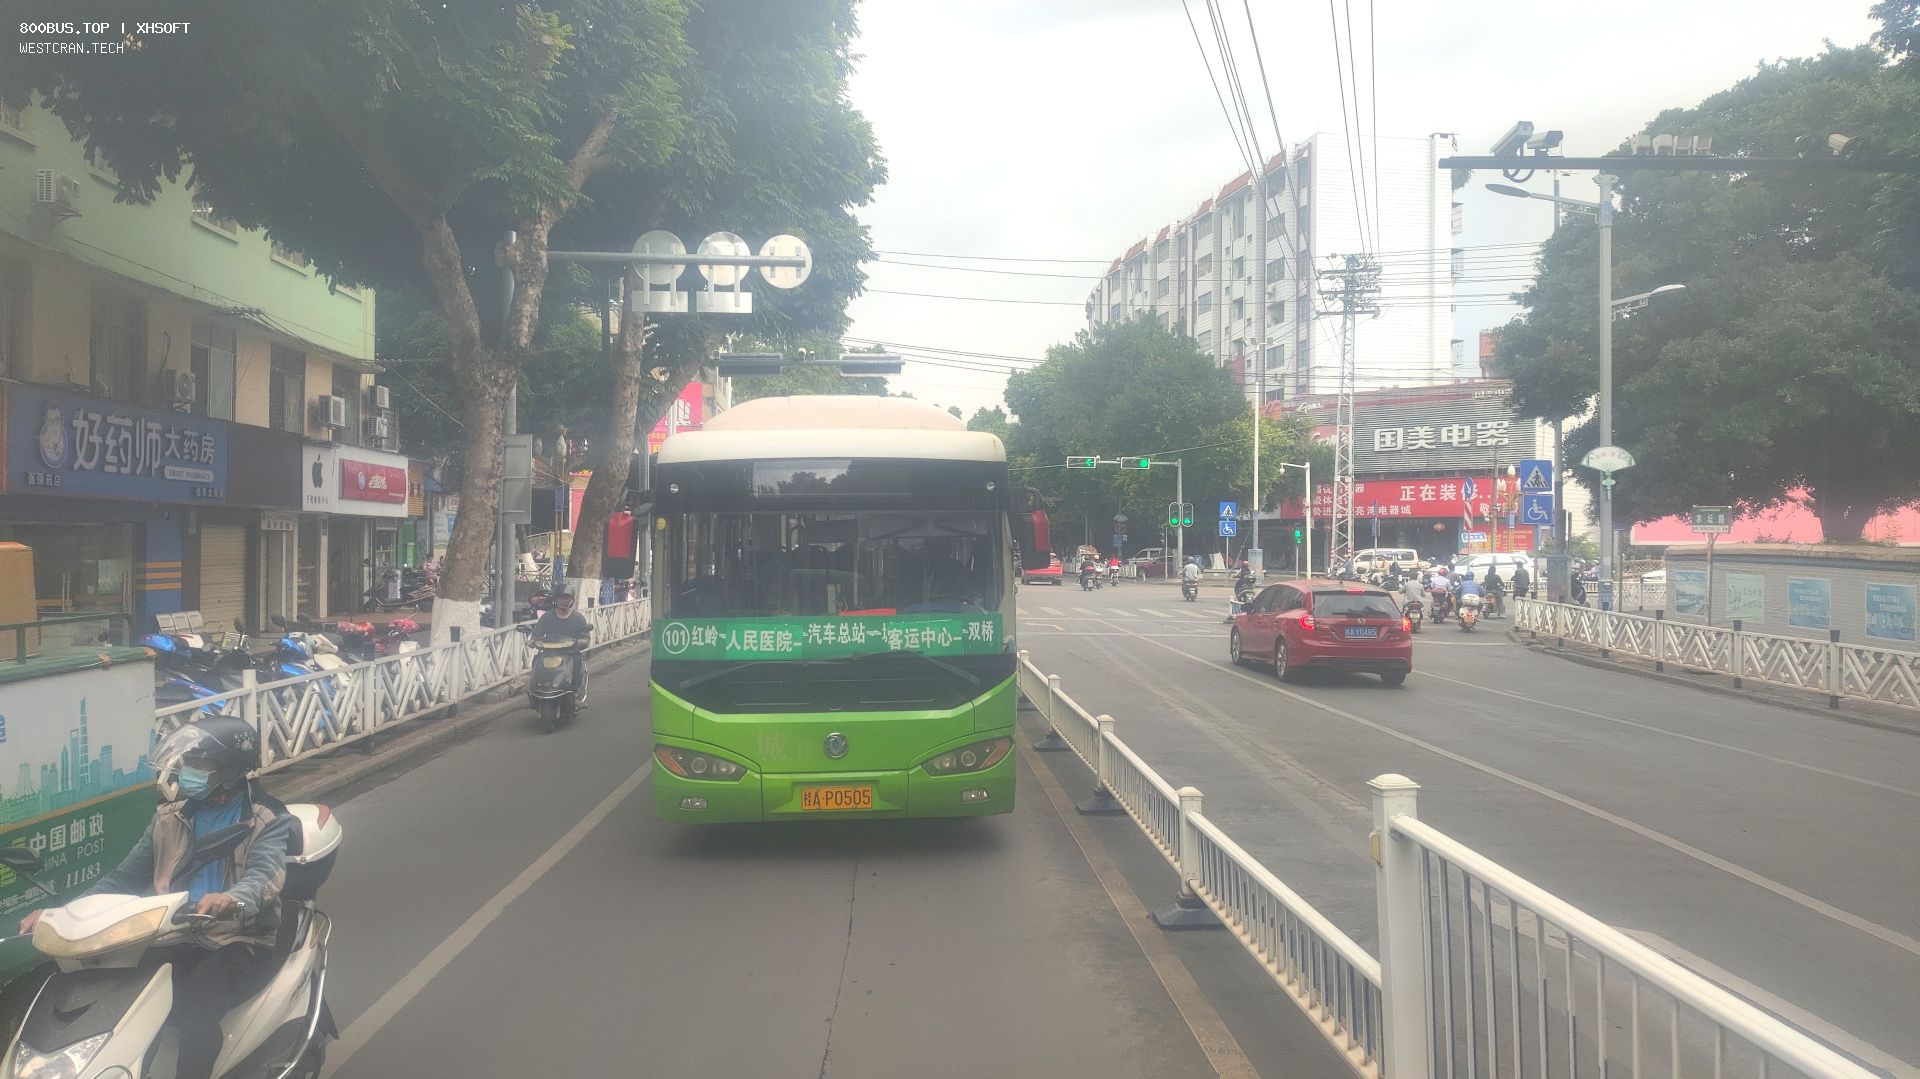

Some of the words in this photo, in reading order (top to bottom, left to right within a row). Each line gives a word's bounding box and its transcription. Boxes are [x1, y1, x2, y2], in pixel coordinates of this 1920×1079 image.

[1374, 421, 1509, 452] 国美电器
[665, 629, 686, 647] 101
[30, 812, 104, 857] 中国邮政
[77, 838, 104, 859] POST
[66, 862, 101, 888] 11183
